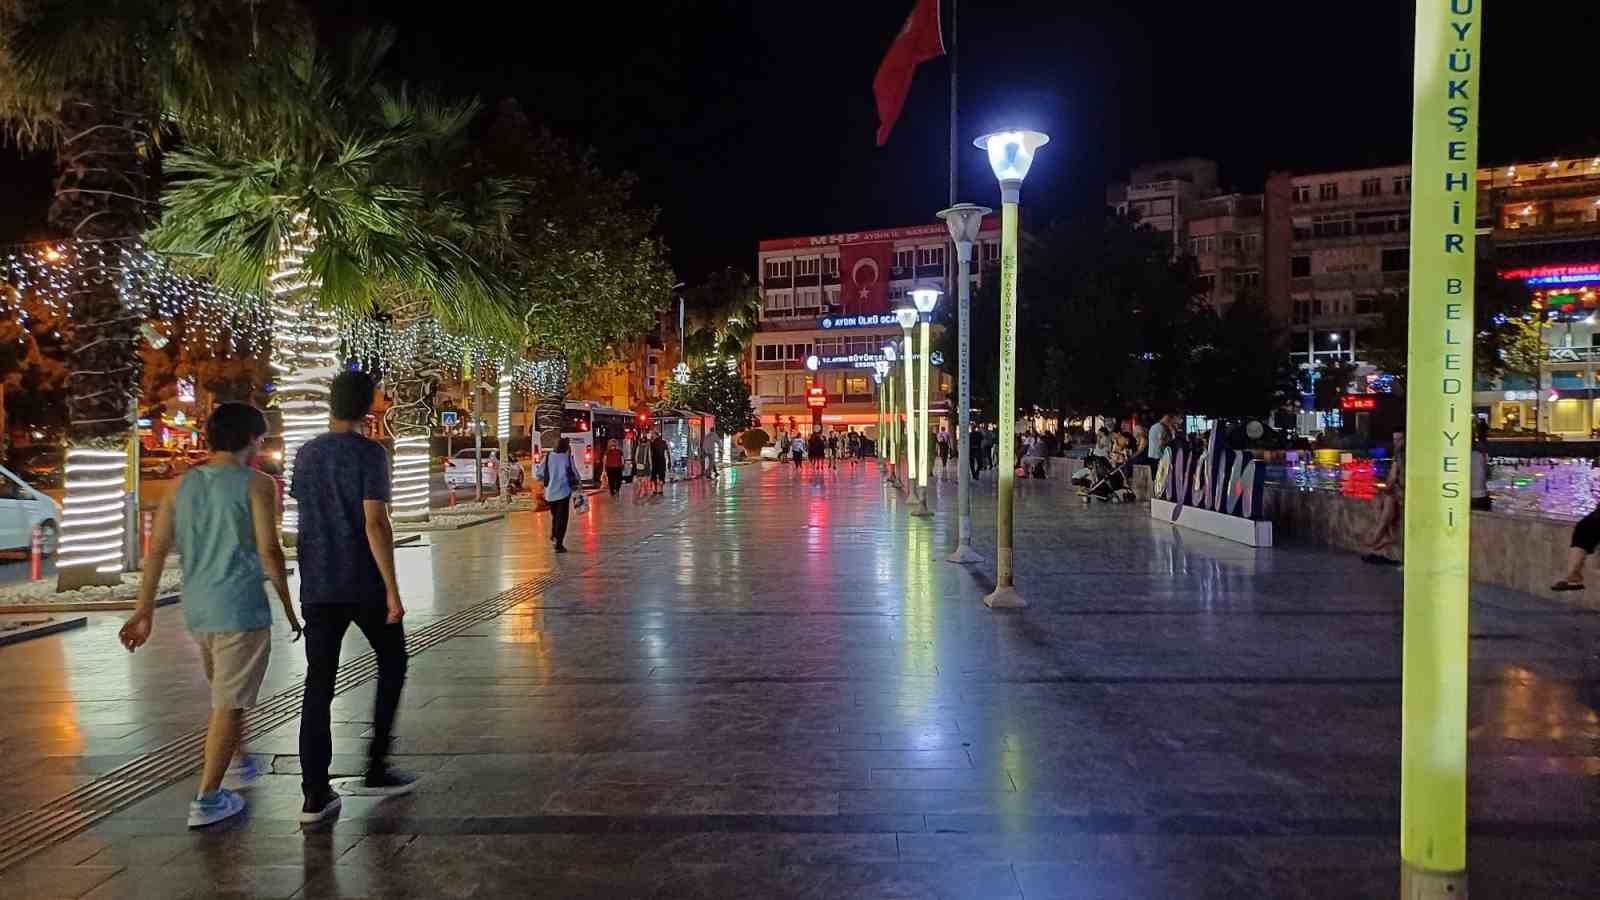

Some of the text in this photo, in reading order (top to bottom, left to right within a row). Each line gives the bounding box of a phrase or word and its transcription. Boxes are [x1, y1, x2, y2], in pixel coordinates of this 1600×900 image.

[810, 233, 860, 245] MHP
[858, 315, 879, 325] ÜLKÜ
[880, 315, 899, 324] OCA
[1441, 278, 1463, 527] BELEDİYESİ
